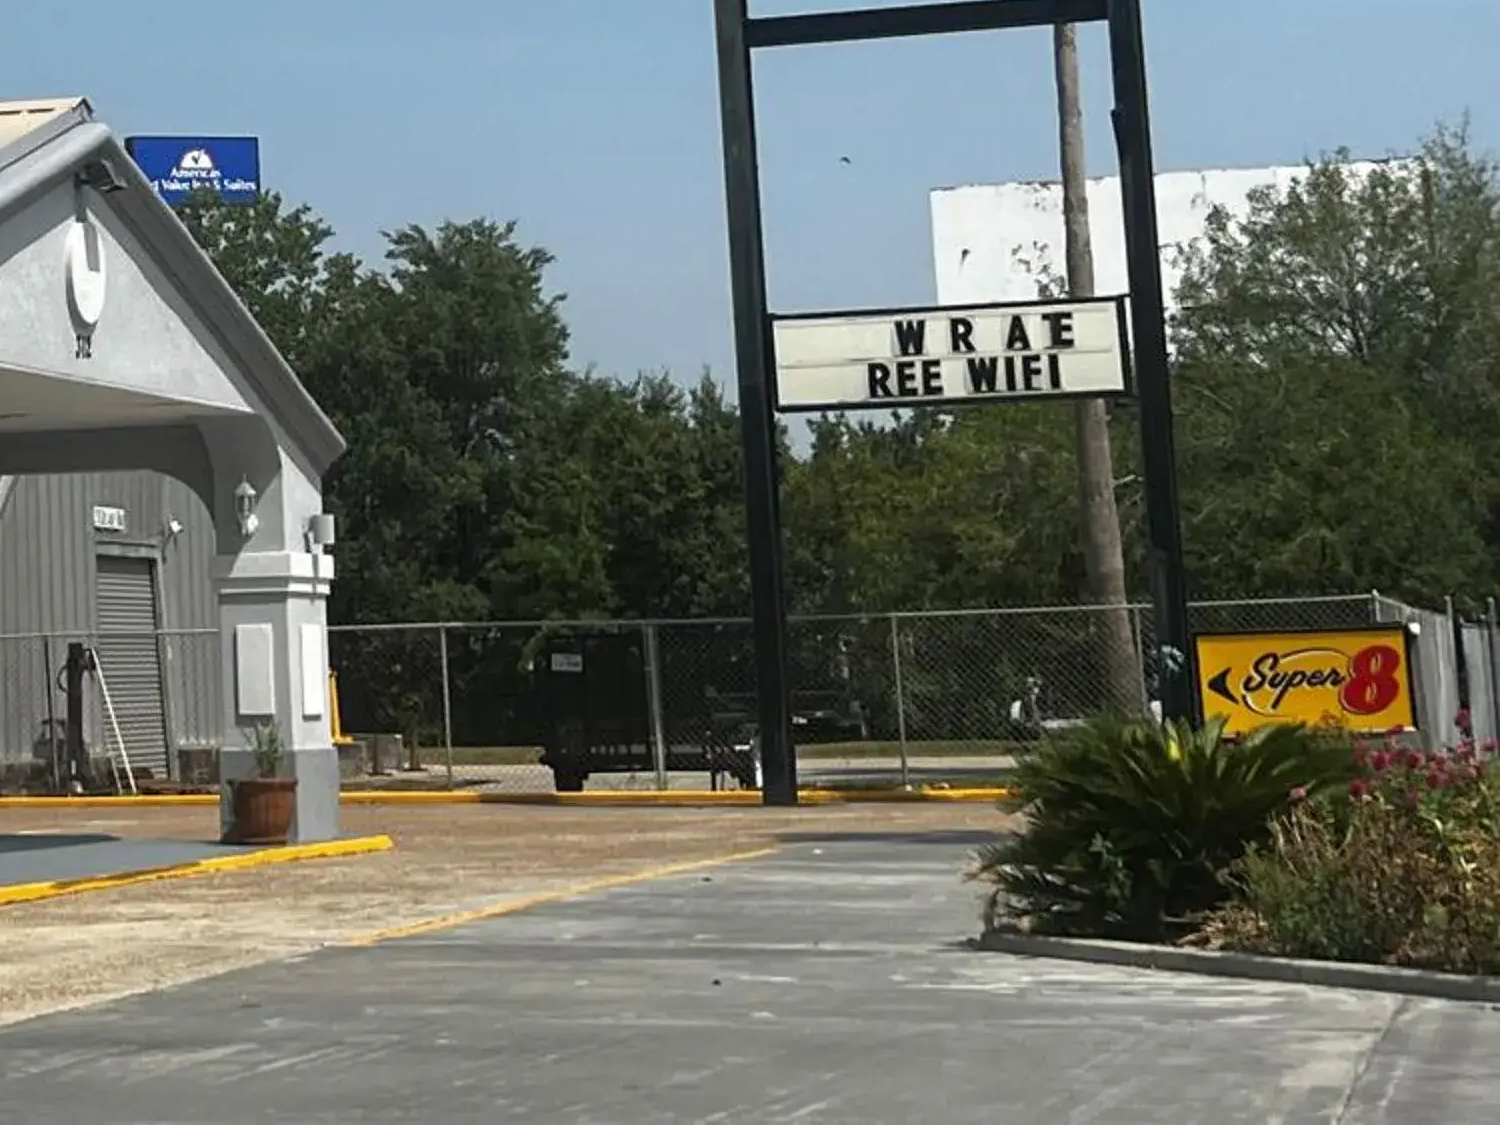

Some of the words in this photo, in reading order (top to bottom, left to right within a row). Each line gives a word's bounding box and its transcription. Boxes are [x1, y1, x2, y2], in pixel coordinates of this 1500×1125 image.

[866, 358, 944, 399] REE
[967, 352, 1061, 394] WIFI
[1243, 651, 1346, 710] Super
[1338, 645, 1401, 716] 8
